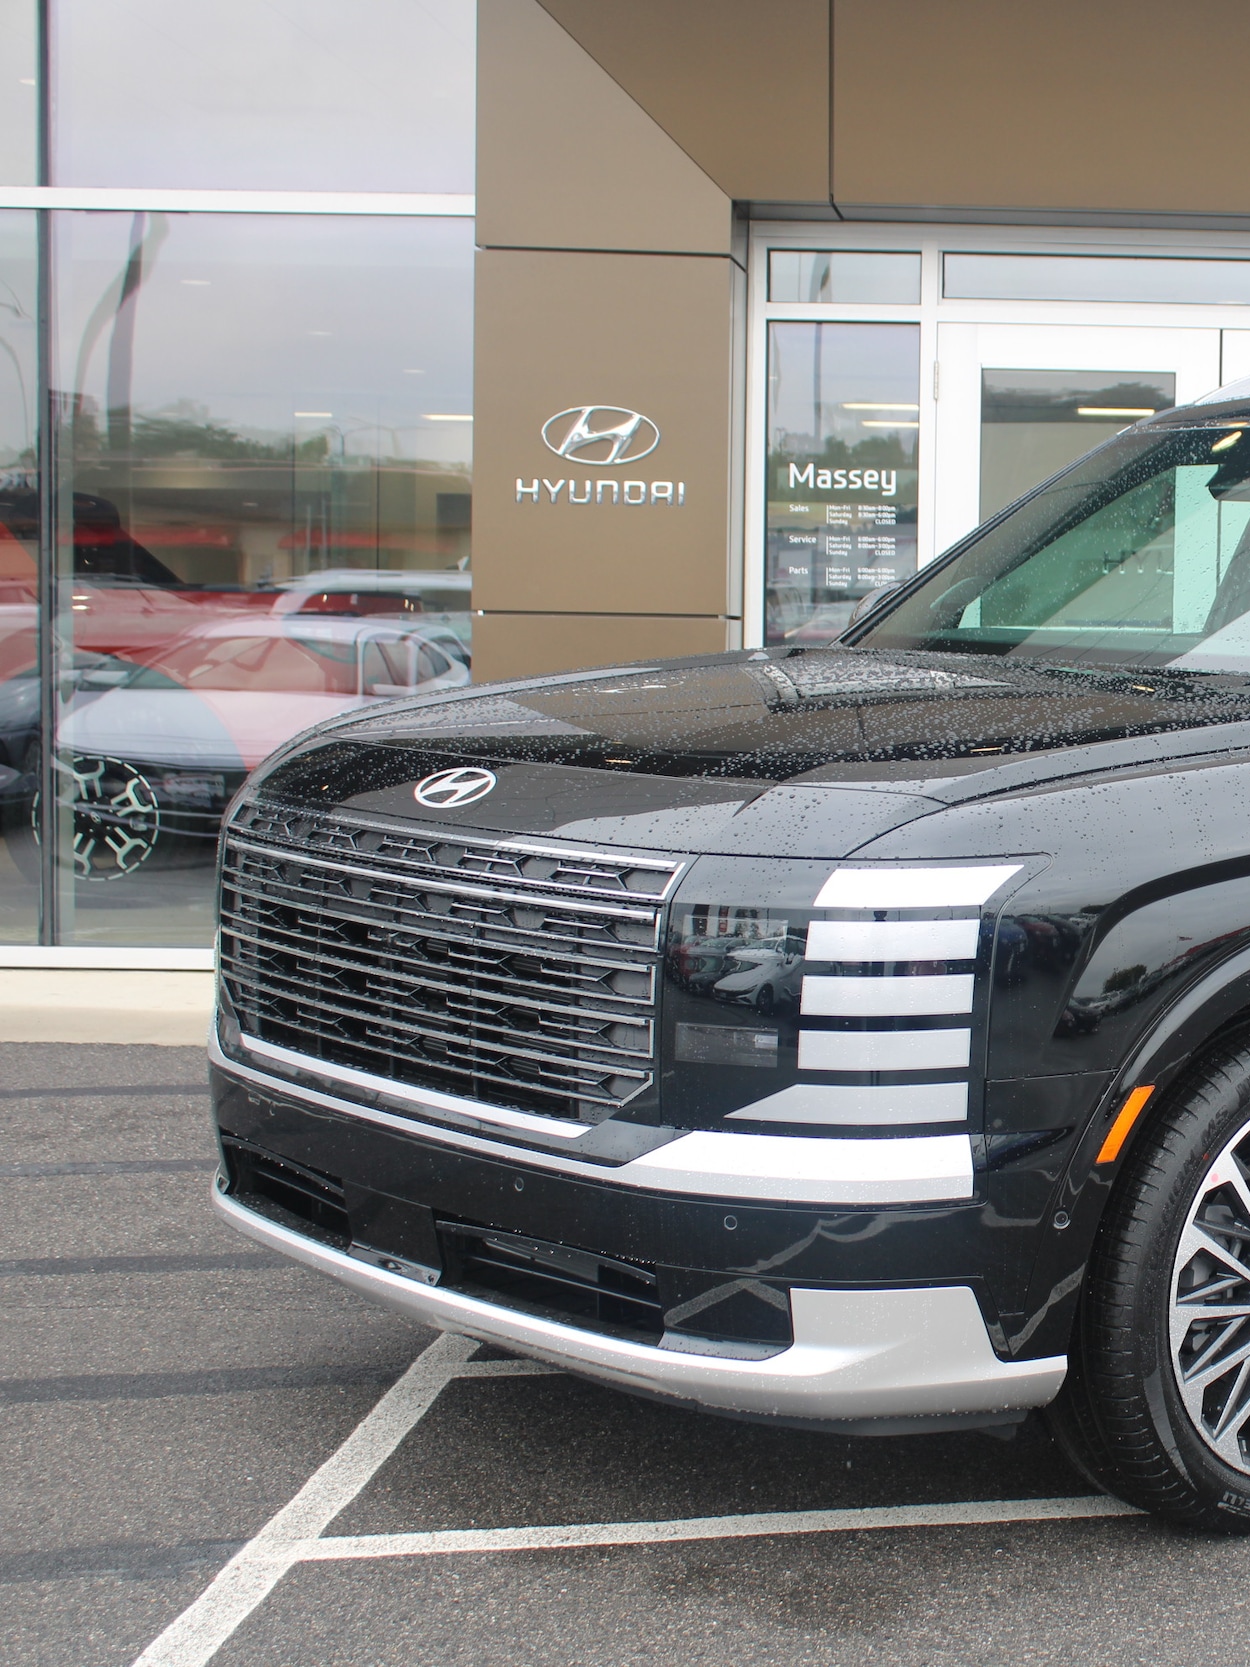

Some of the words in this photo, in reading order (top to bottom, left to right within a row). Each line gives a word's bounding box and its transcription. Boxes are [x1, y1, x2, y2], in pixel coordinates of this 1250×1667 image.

[789, 463, 896, 496] Massey
[515, 478, 685, 506] HYUNDAI
[789, 504, 809, 512] Sales
[789, 535, 817, 543] Service
[789, 567, 808, 575] Parts
